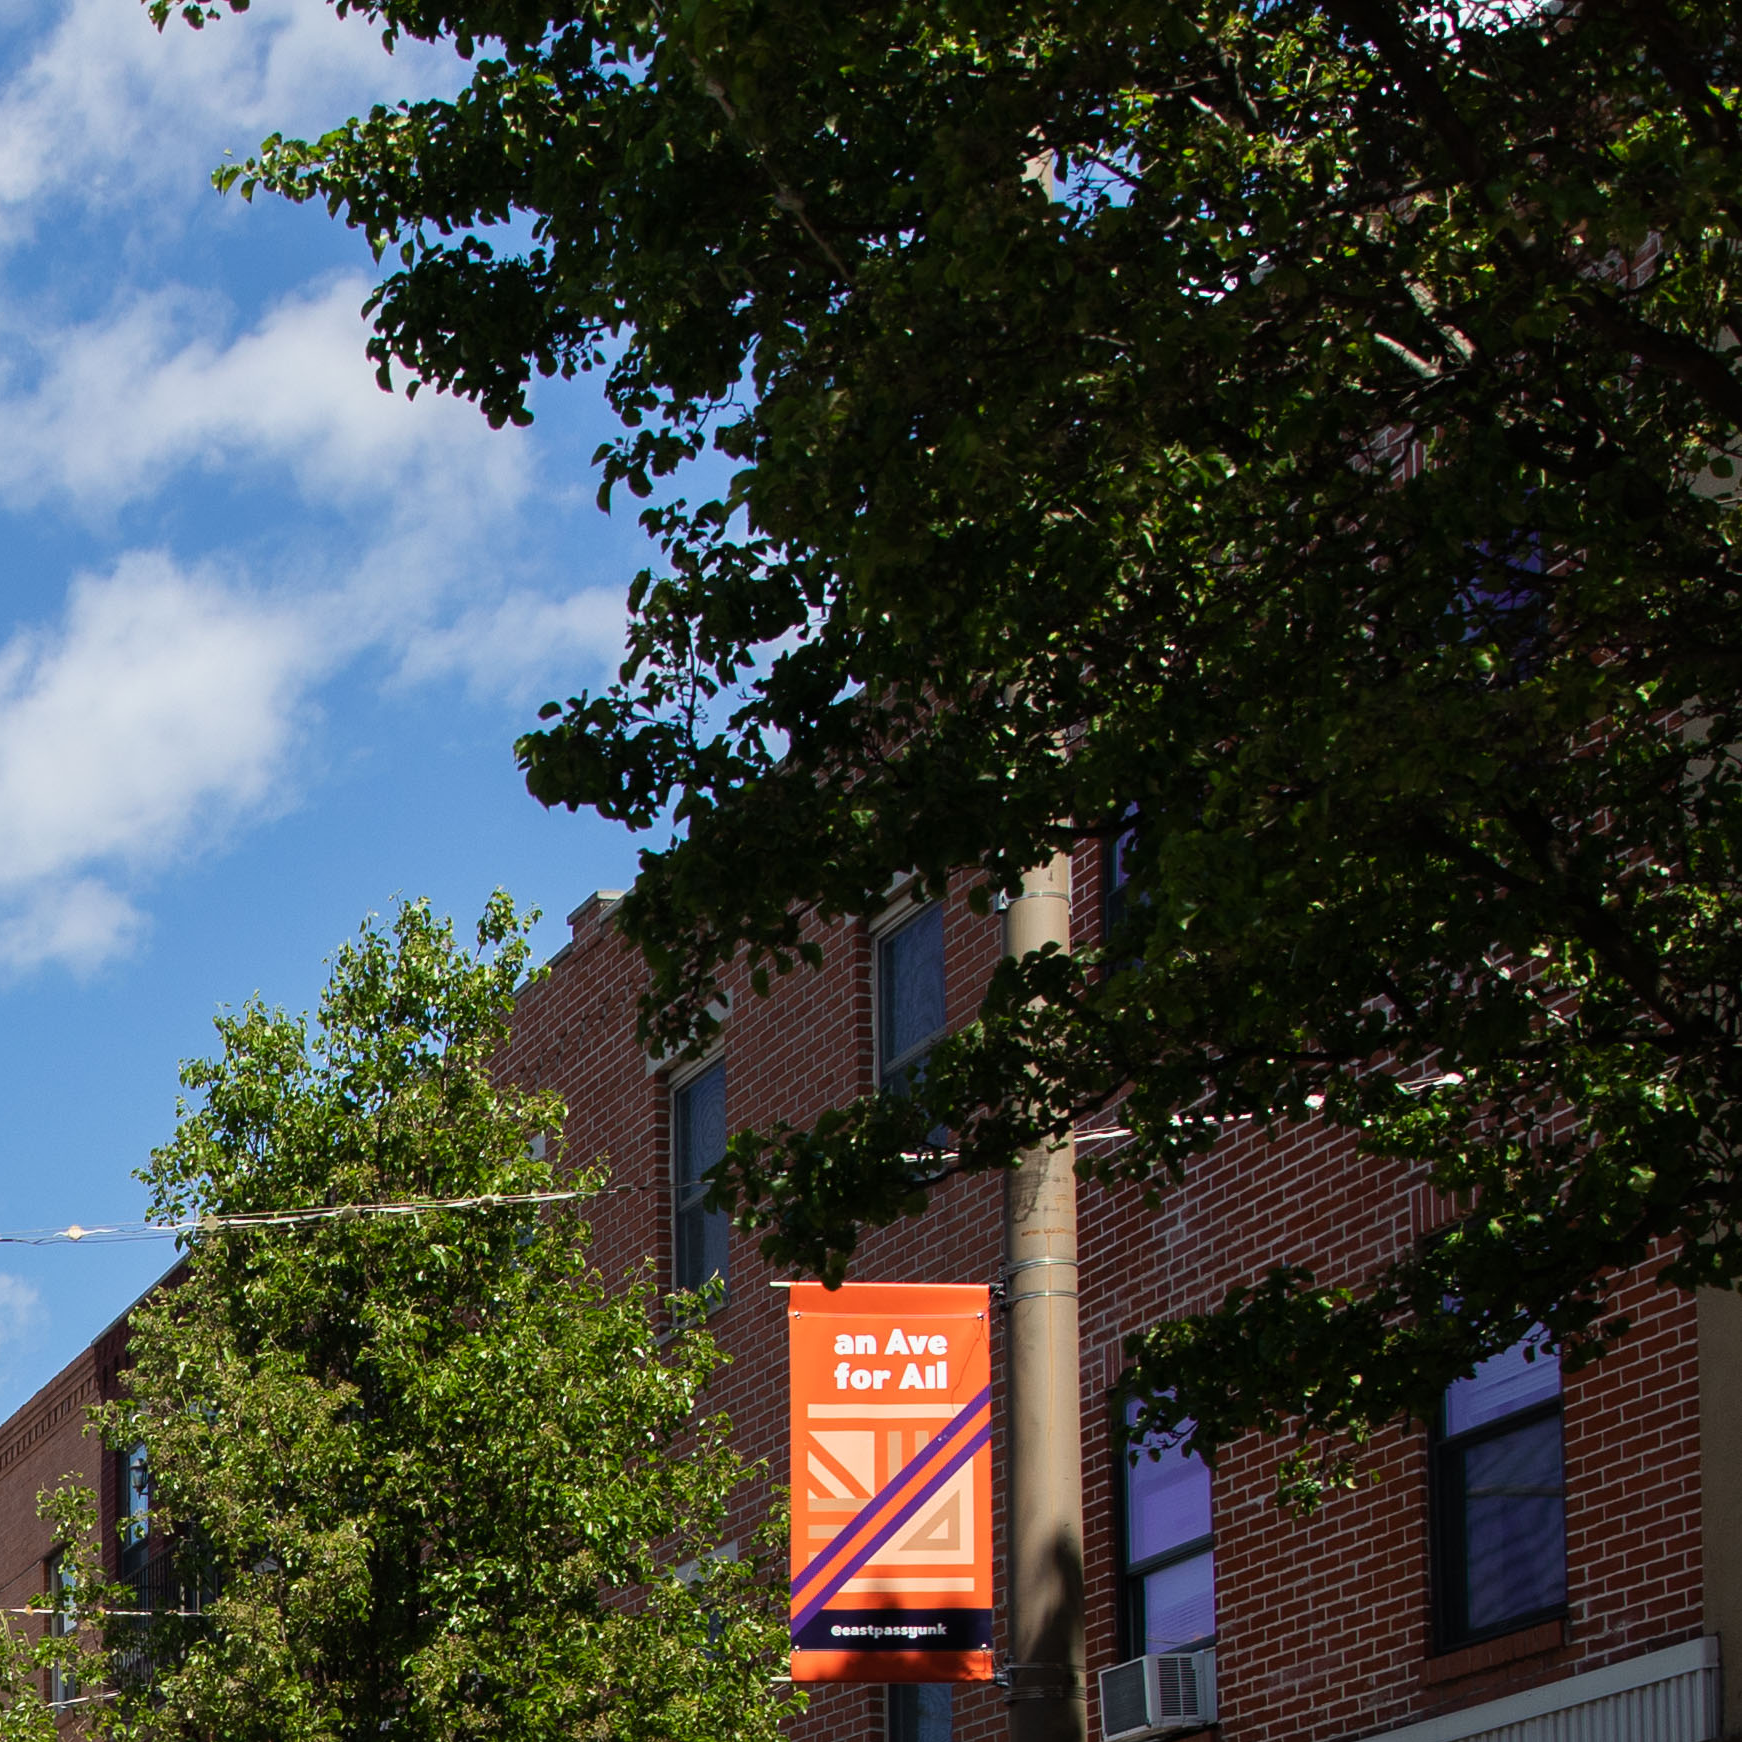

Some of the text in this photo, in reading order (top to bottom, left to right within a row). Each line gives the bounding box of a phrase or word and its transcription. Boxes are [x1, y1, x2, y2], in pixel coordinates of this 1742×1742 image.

[833, 1327, 949, 1356] an Ave
[833, 1361, 949, 1390] for All
[830, 1623, 948, 1640] @eastpassyunk
